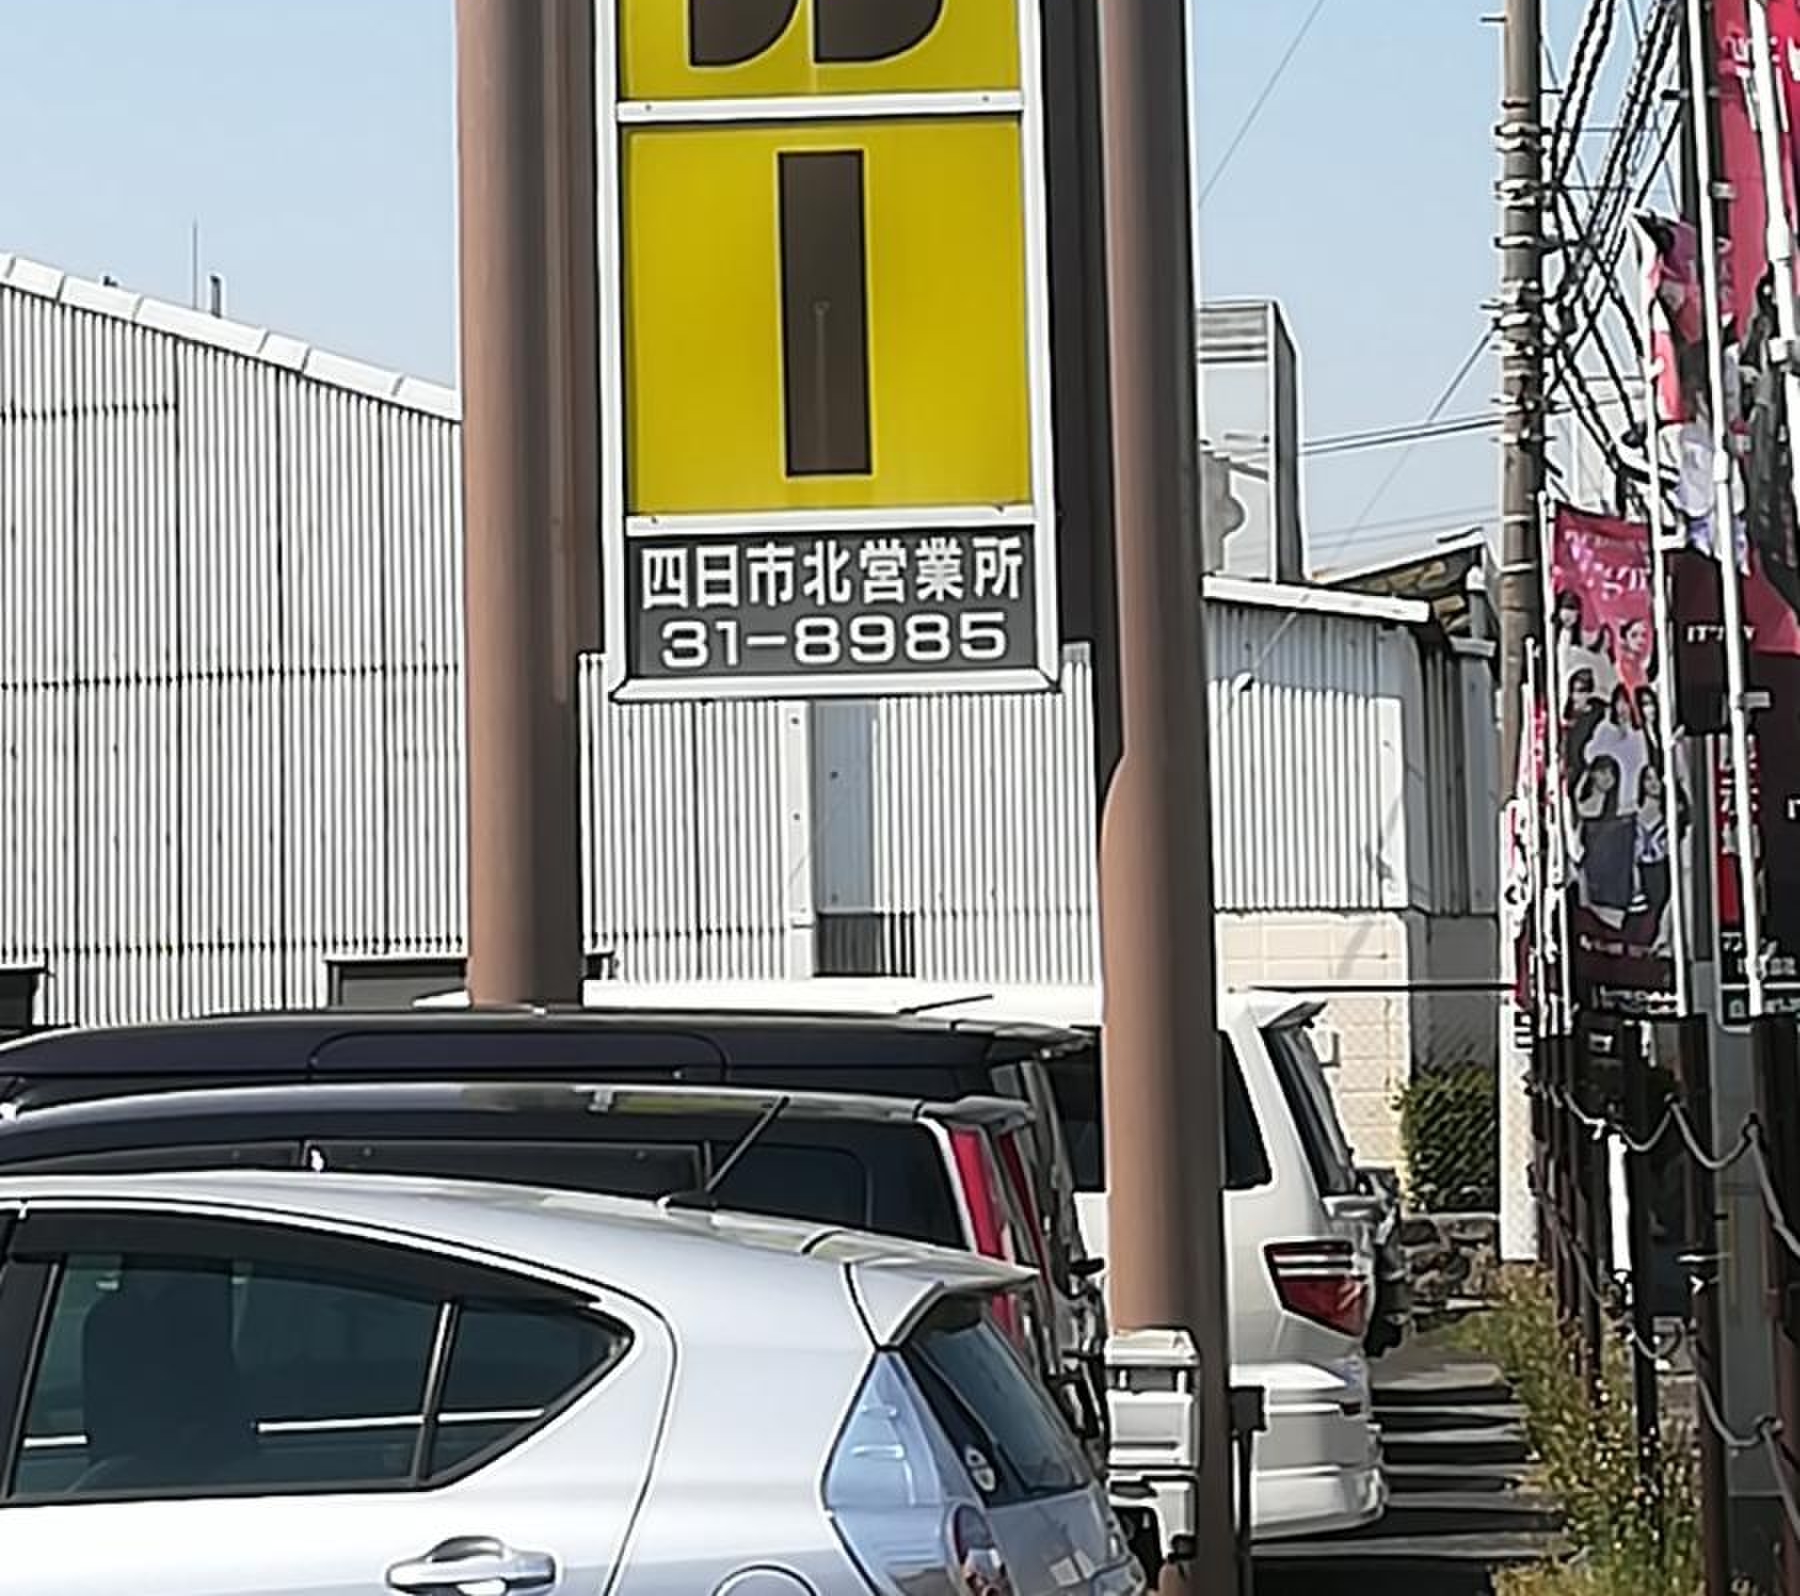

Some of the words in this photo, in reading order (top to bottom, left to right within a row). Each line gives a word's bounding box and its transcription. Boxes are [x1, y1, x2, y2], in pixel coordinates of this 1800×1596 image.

[641, 536, 1023, 610] 四日市北営業所
[661, 611, 1007, 669] 31-8985
